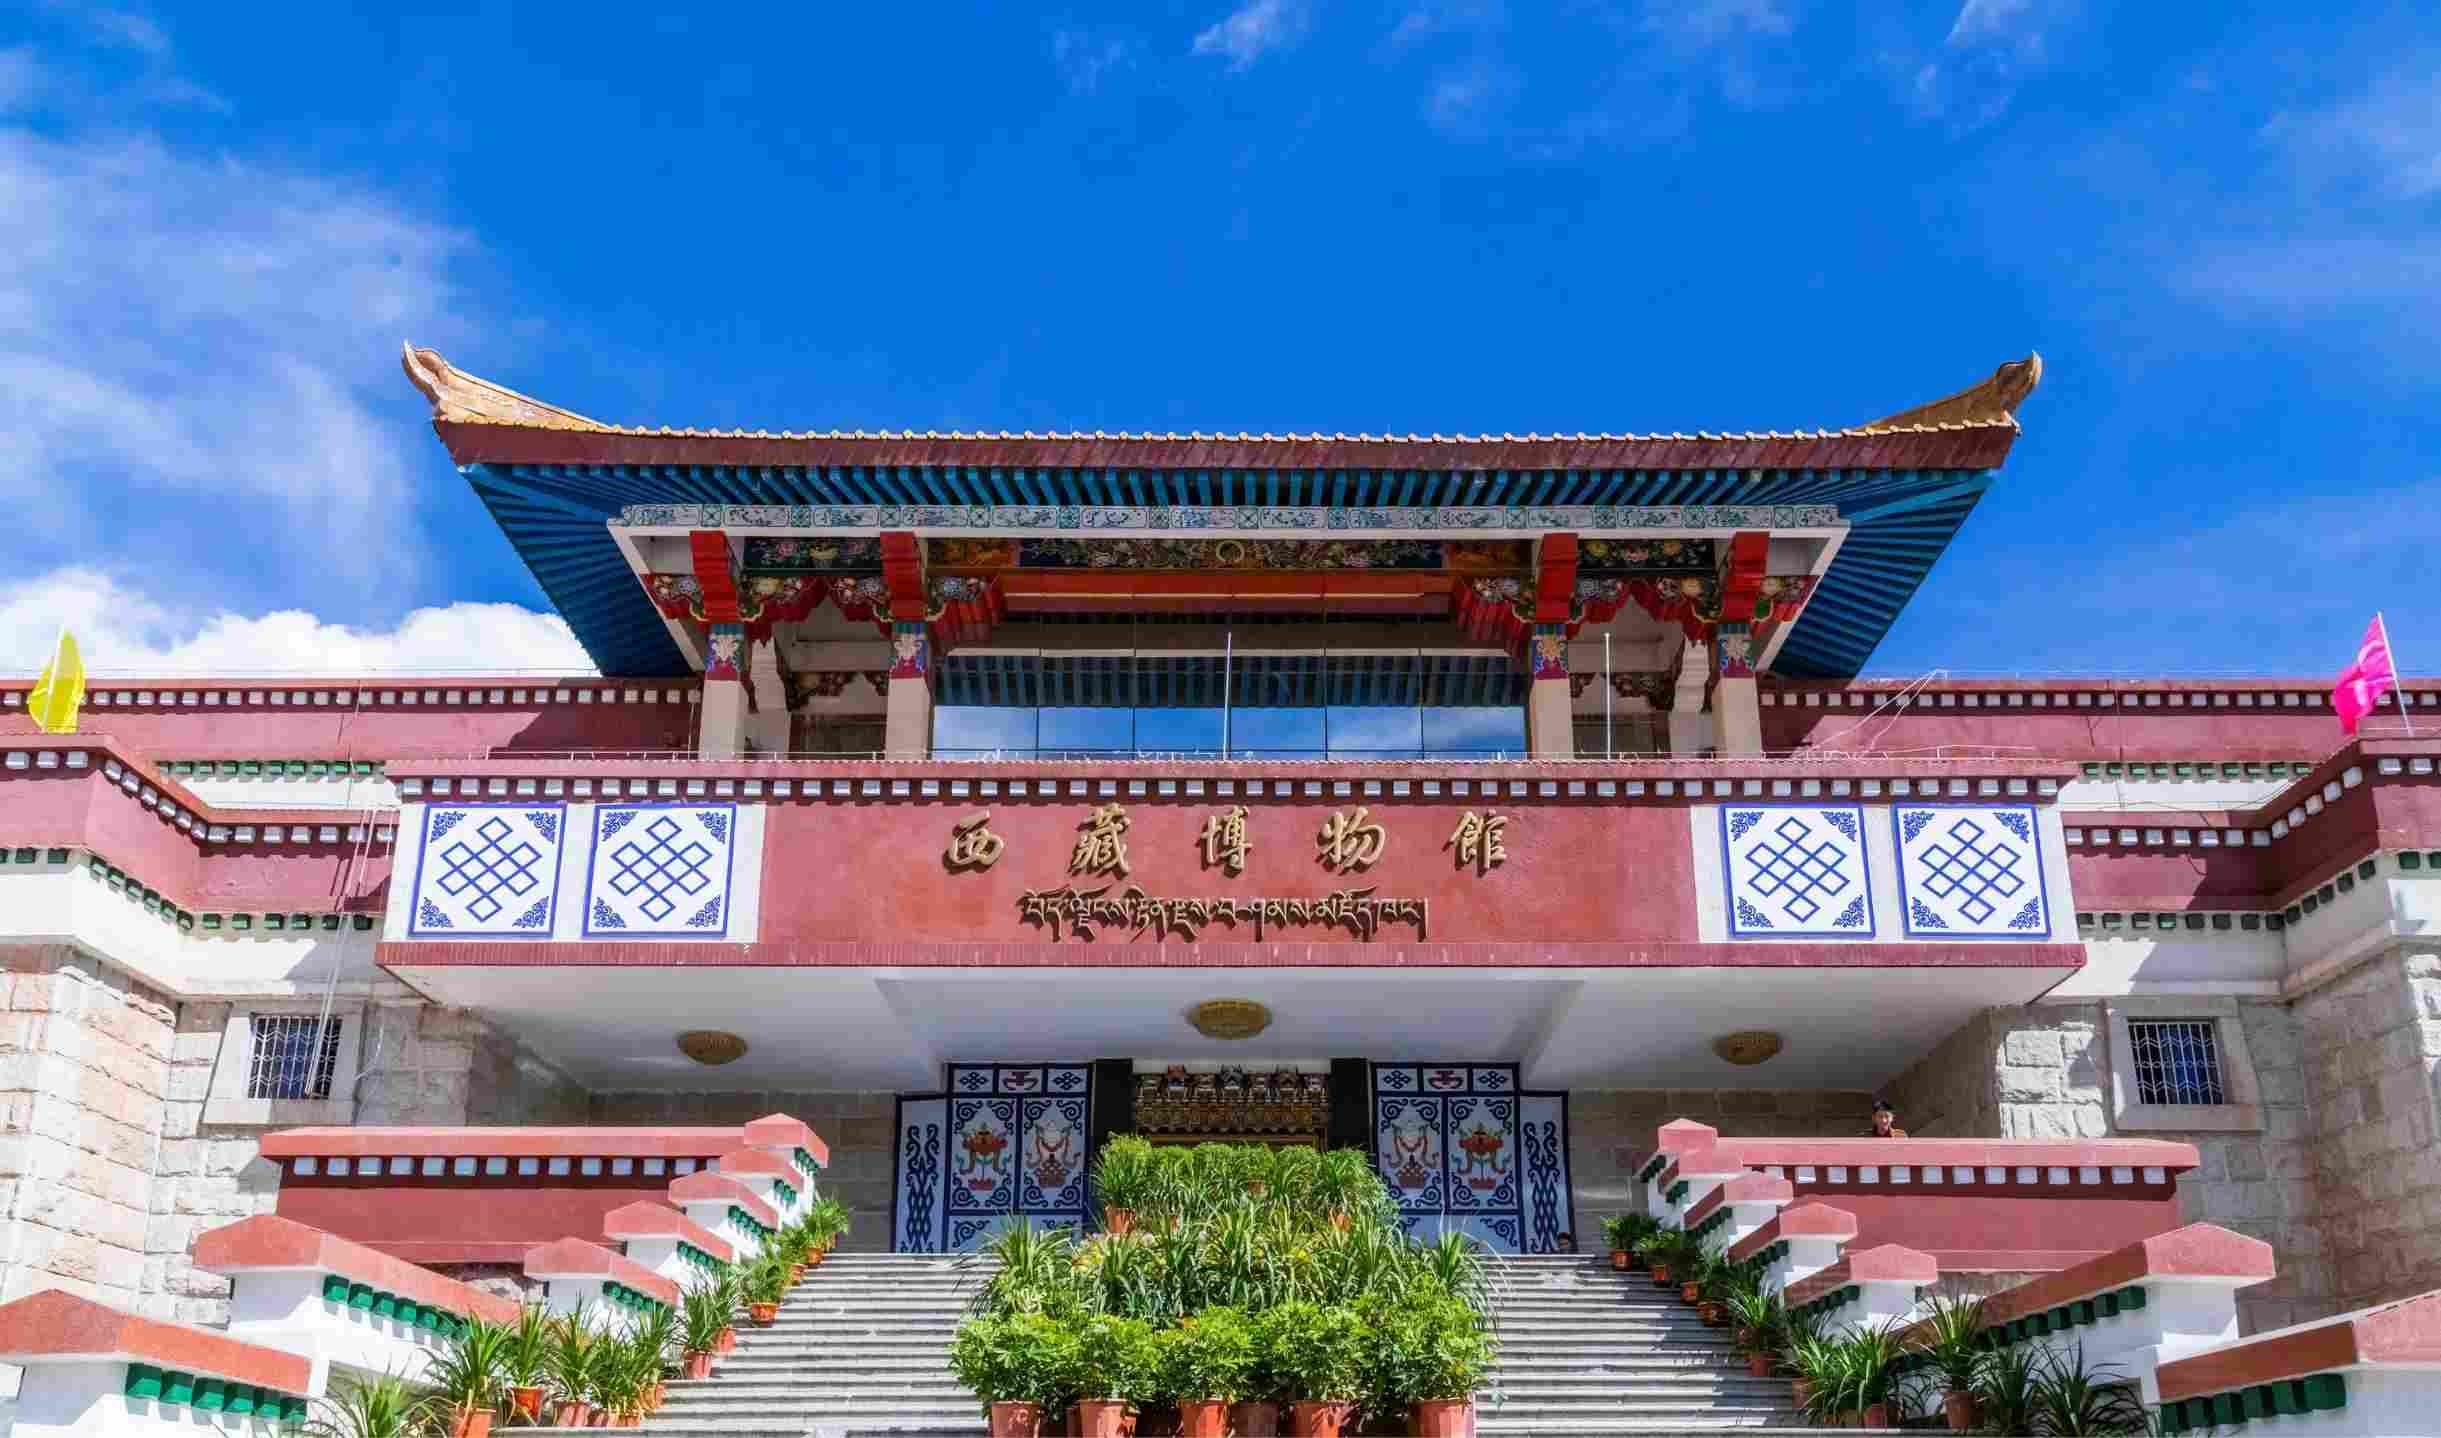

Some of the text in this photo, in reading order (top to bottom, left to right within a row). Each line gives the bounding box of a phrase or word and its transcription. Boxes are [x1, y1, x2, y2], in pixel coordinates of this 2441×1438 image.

[946, 803, 1509, 876] 西藏博物館
